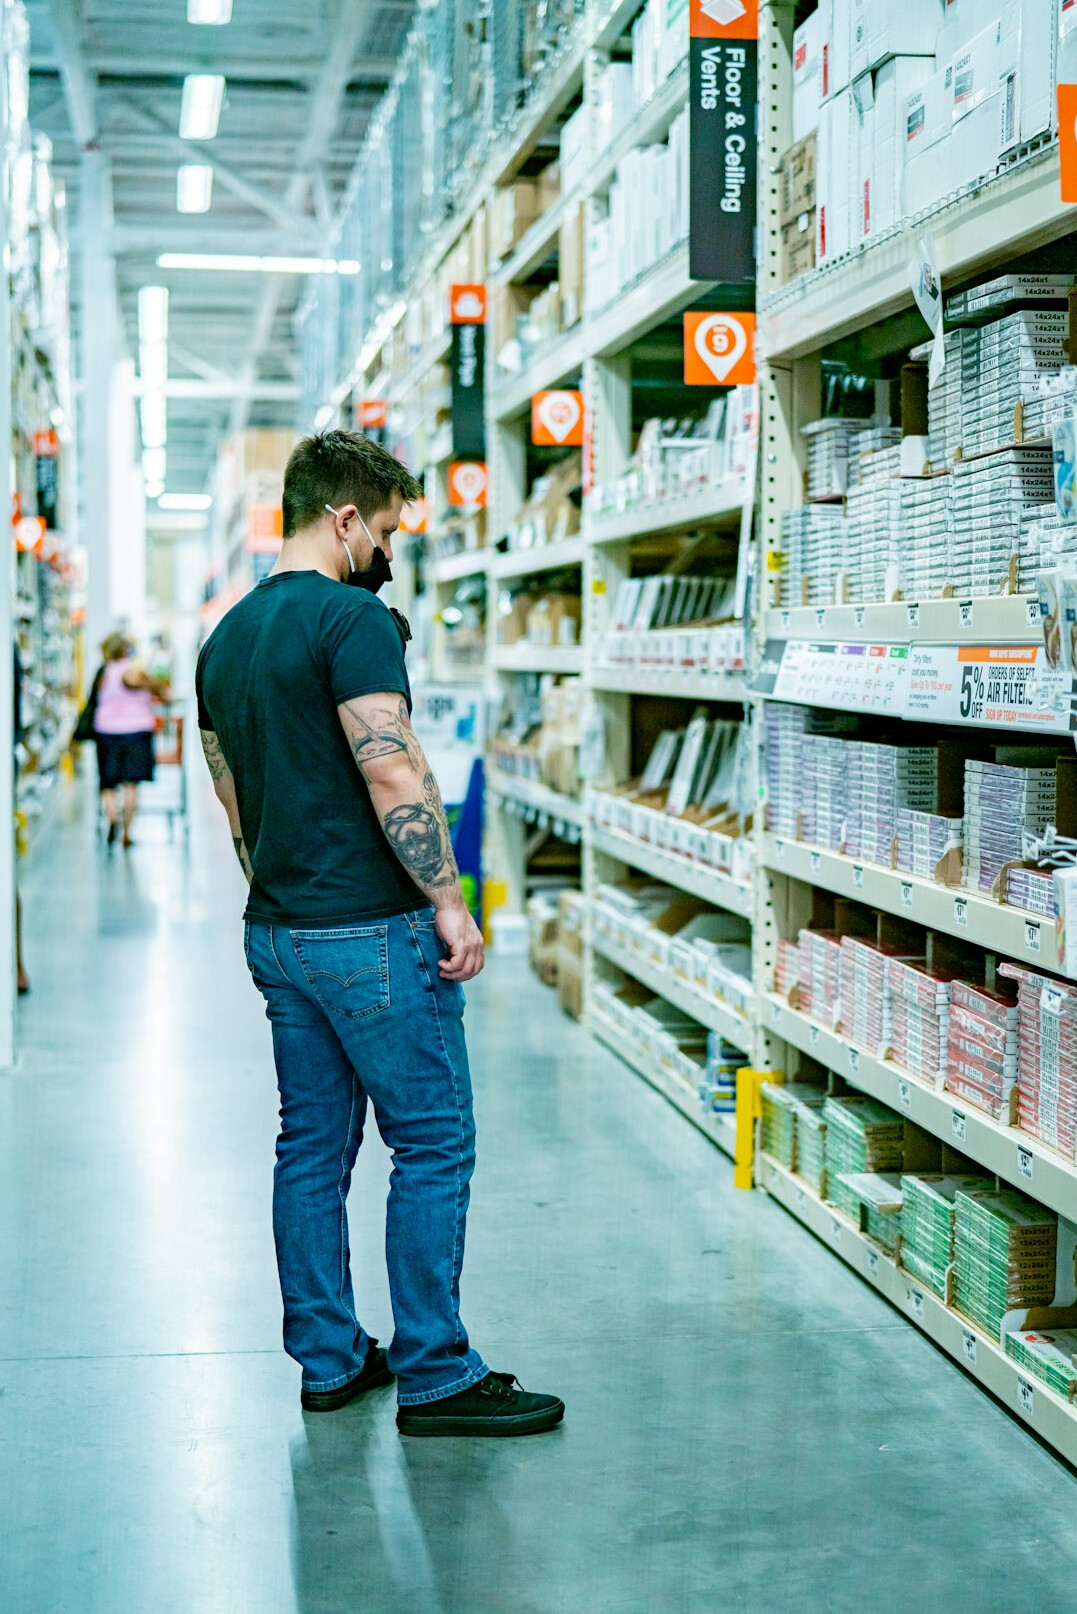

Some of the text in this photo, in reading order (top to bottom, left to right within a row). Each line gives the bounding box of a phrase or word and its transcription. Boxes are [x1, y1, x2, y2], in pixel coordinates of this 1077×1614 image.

[701, 45, 722, 110] Vents
[720, 48, 746, 213] Floor & Ceiling
[1034, 324, 1065, 332] 14x24x1
[712, 333, 729, 353] 9
[1034, 336, 1064, 344] 14x24x1
[1021, 478, 1053, 486] 14x24x1
[1022, 490, 1053, 498] 14x24x1
[988, 666, 1008, 680] ORDERS
[1009, 667, 1016, 680] OF
[986, 681, 1001, 703] AIR
[1002, 682, 1033, 706] FILTE
[971, 702, 983, 718] OFF
[986, 708, 996, 720] SIGN
